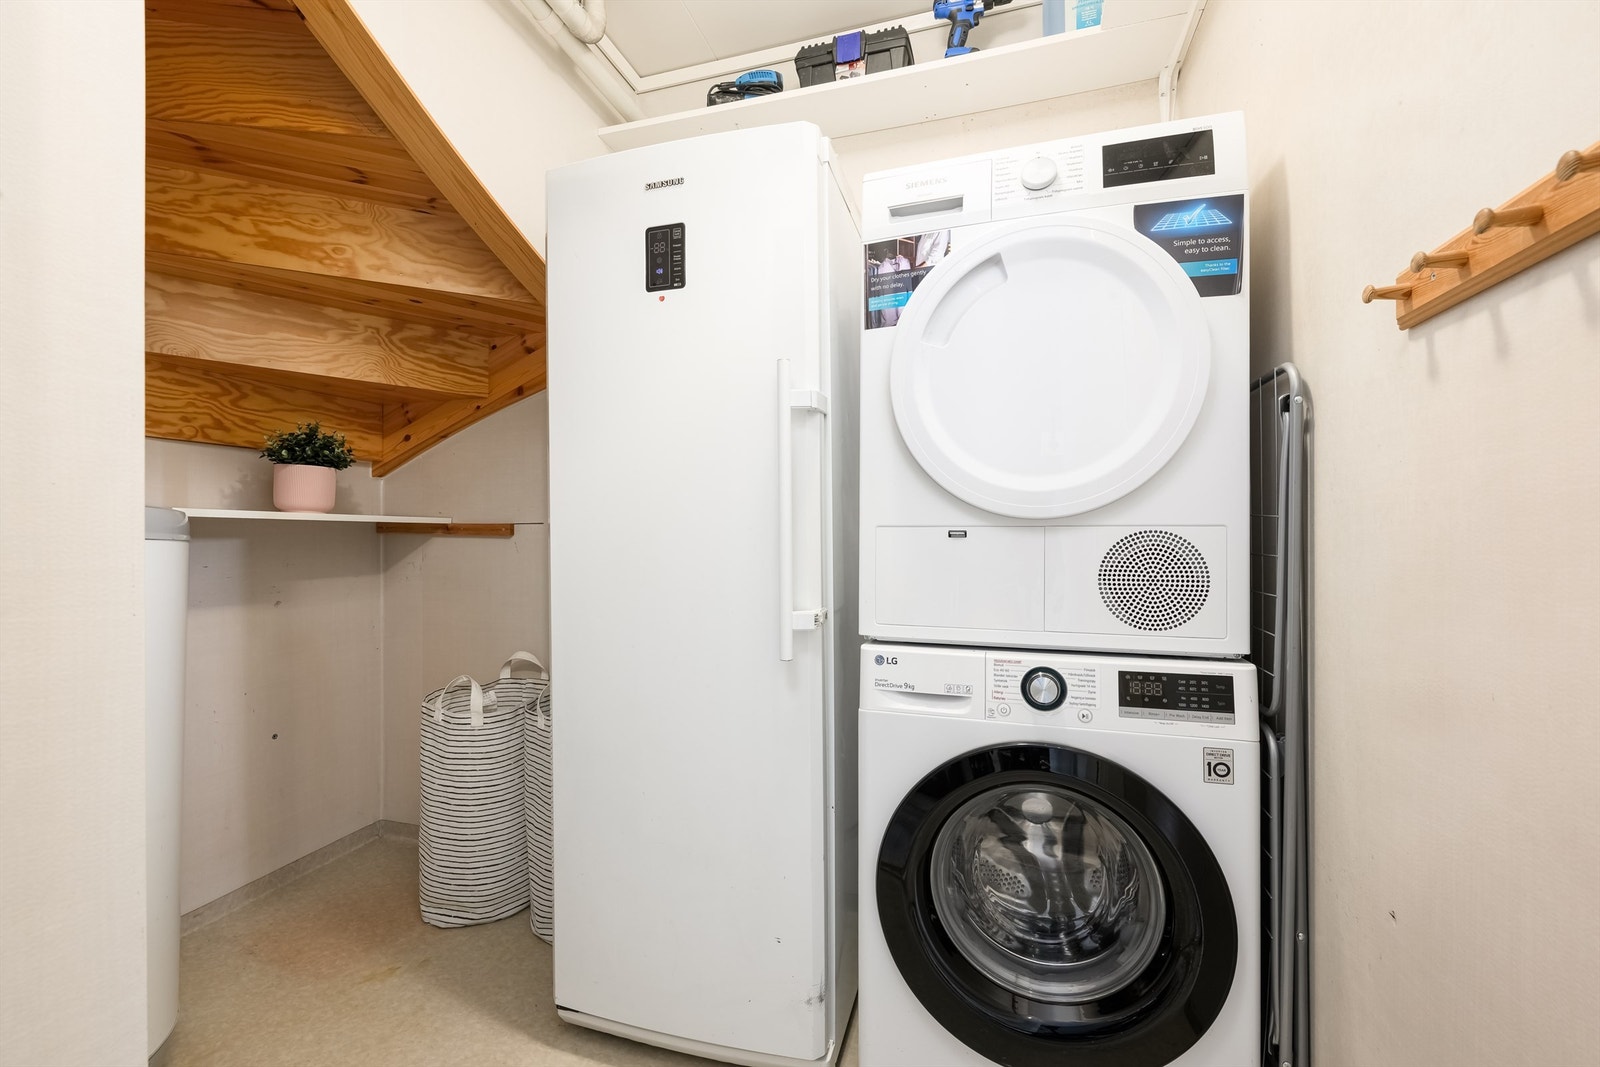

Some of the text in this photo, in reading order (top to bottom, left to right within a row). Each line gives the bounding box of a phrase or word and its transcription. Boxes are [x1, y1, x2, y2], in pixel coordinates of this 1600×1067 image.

[645, 177, 685, 191] SAMSUNG
[905, 177, 948, 190] SIEMENS
[1173, 239, 1197, 247] Simple
[910, 270, 927, 278] gently
[886, 657, 898, 665] LG
[1206, 761, 1231, 778] 10
